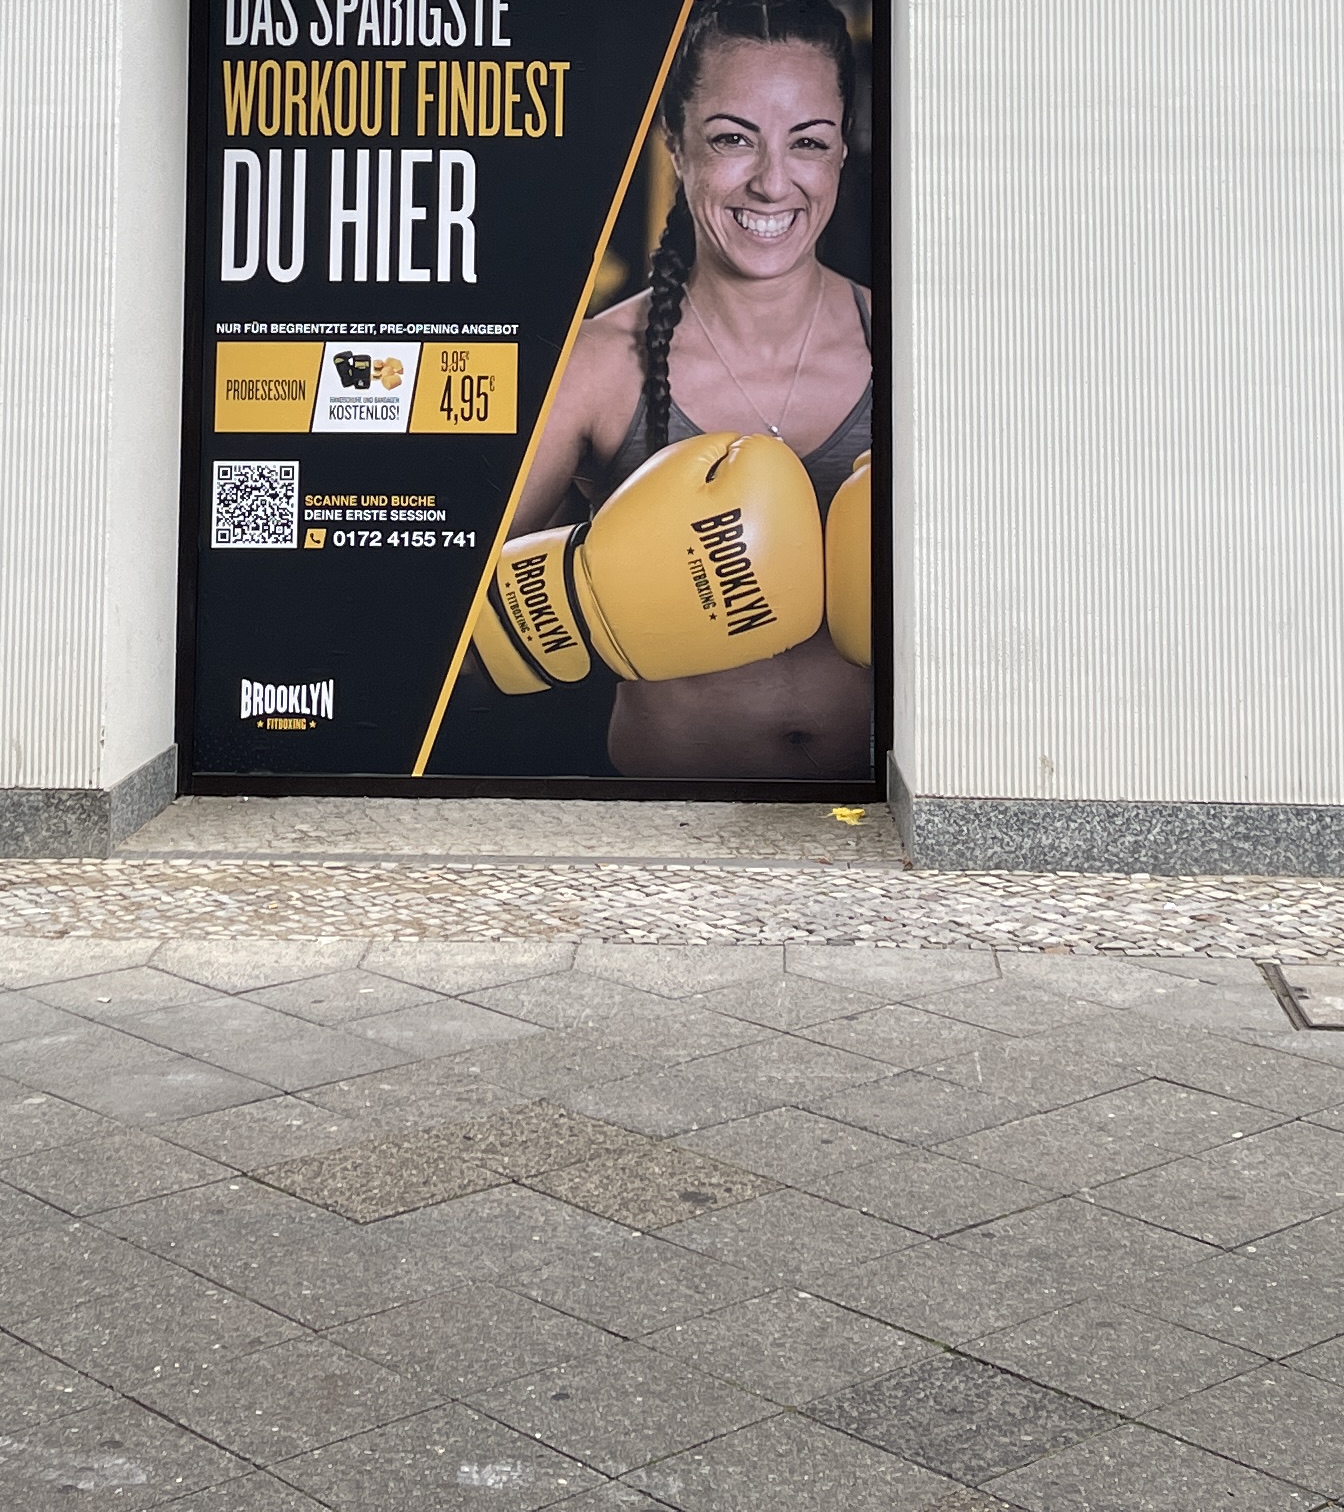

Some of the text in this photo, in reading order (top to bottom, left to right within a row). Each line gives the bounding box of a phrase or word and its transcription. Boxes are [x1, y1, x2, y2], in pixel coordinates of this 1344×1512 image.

[222, 59, 570, 138] WORKOUT FINDEST
[220, 148, 477, 283] DU HIER
[216, 321, 519, 335] NUR FÜR BEGRENTZTE ZEIT, PRE-OPENING ANGEBOT
[226, 379, 306, 401] PROBESESSION
[329, 405, 399, 420] KOSTENLOS!
[305, 495, 435, 507] SCANNE UND BUCHE
[305, 510, 446, 521] DEINE ERSTE SESSION
[333, 531, 475, 547] 0172 4155 741
[688, 558, 716, 610] FITBOXING
[690, 508, 777, 636] BROOKLYN
[506, 591, 530, 633] FITBOXING
[512, 553, 578, 654] BROOKLYN
[241, 678, 334, 720] BROOKLYN
[267, 718, 307, 730] FITBOXING
